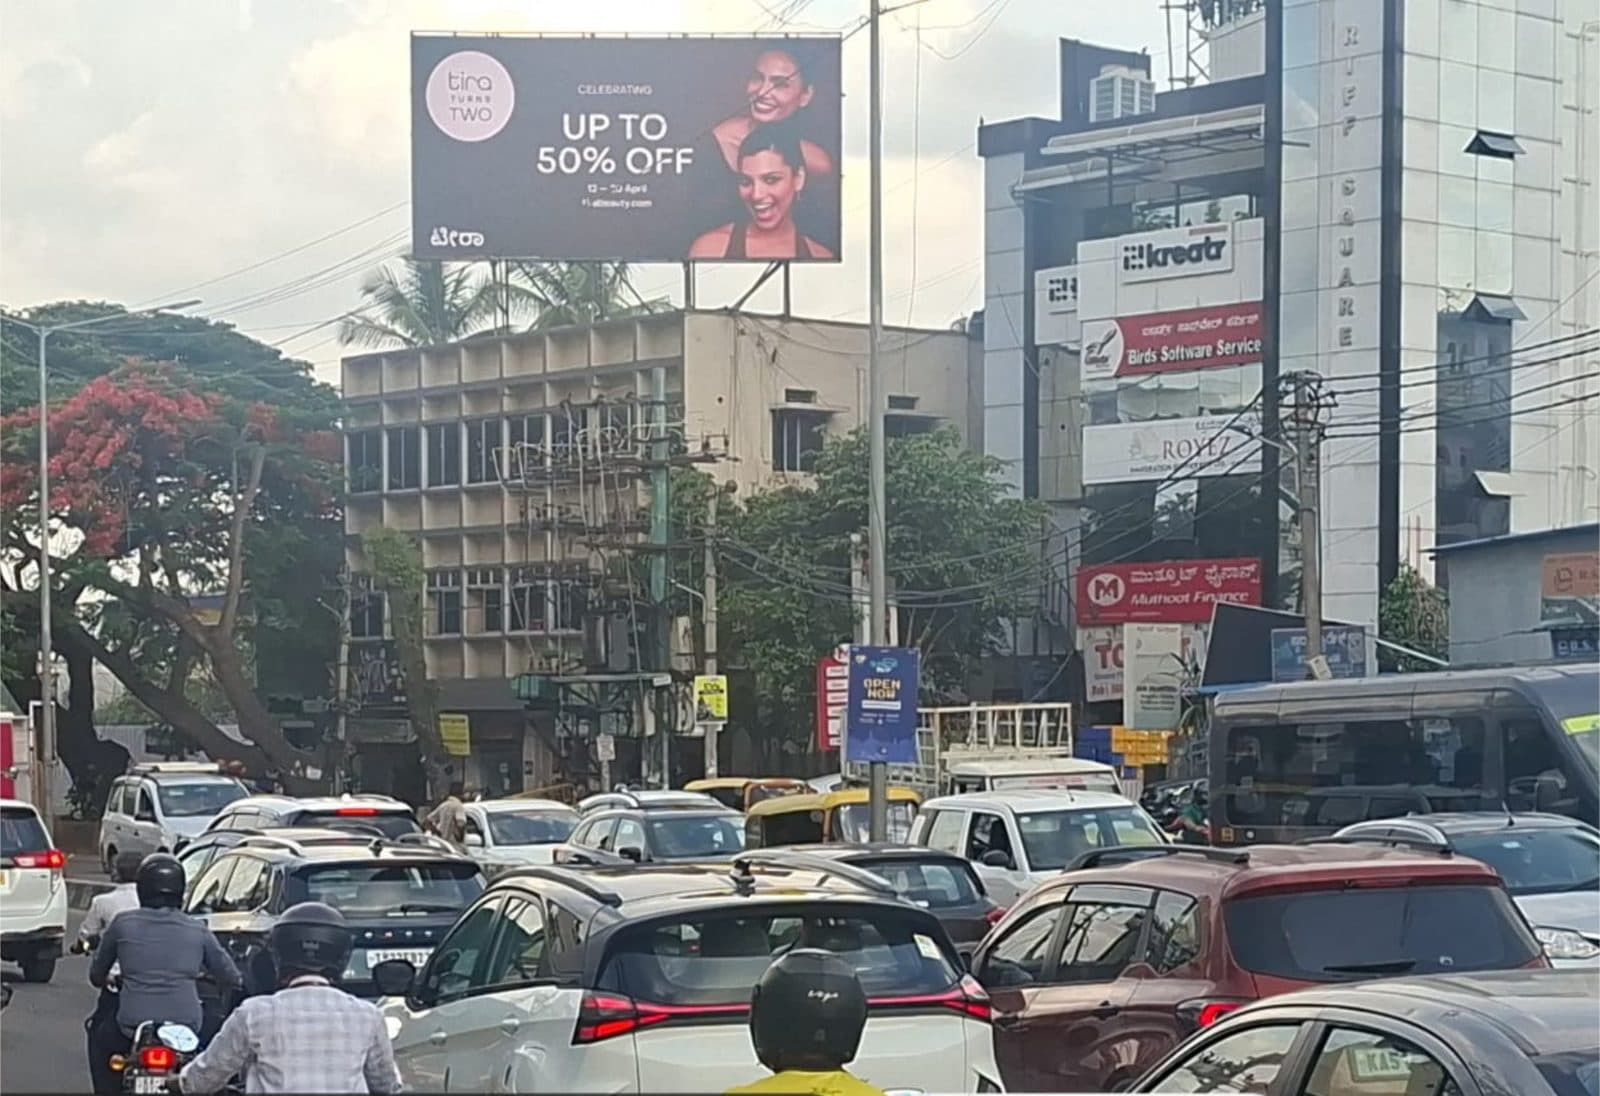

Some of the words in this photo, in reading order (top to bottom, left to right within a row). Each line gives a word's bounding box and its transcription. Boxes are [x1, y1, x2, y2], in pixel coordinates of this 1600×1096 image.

[448, 72, 492, 91] tira
[577, 84, 652, 95] CELEBRATING
[449, 107, 492, 121] TWO
[562, 113, 610, 140] UP
[618, 113, 667, 140] TO
[536, 146, 616, 174] 50%
[626, 147, 694, 174] OFF
[1128, 347, 1157, 365] Birds
[1160, 344, 1213, 362] Software
[1216, 337, 1261, 356] Service
[1131, 593, 1190, 606] Muthoot
[1193, 590, 1249, 603] Finance
[863, 679, 900, 690] OPEN
